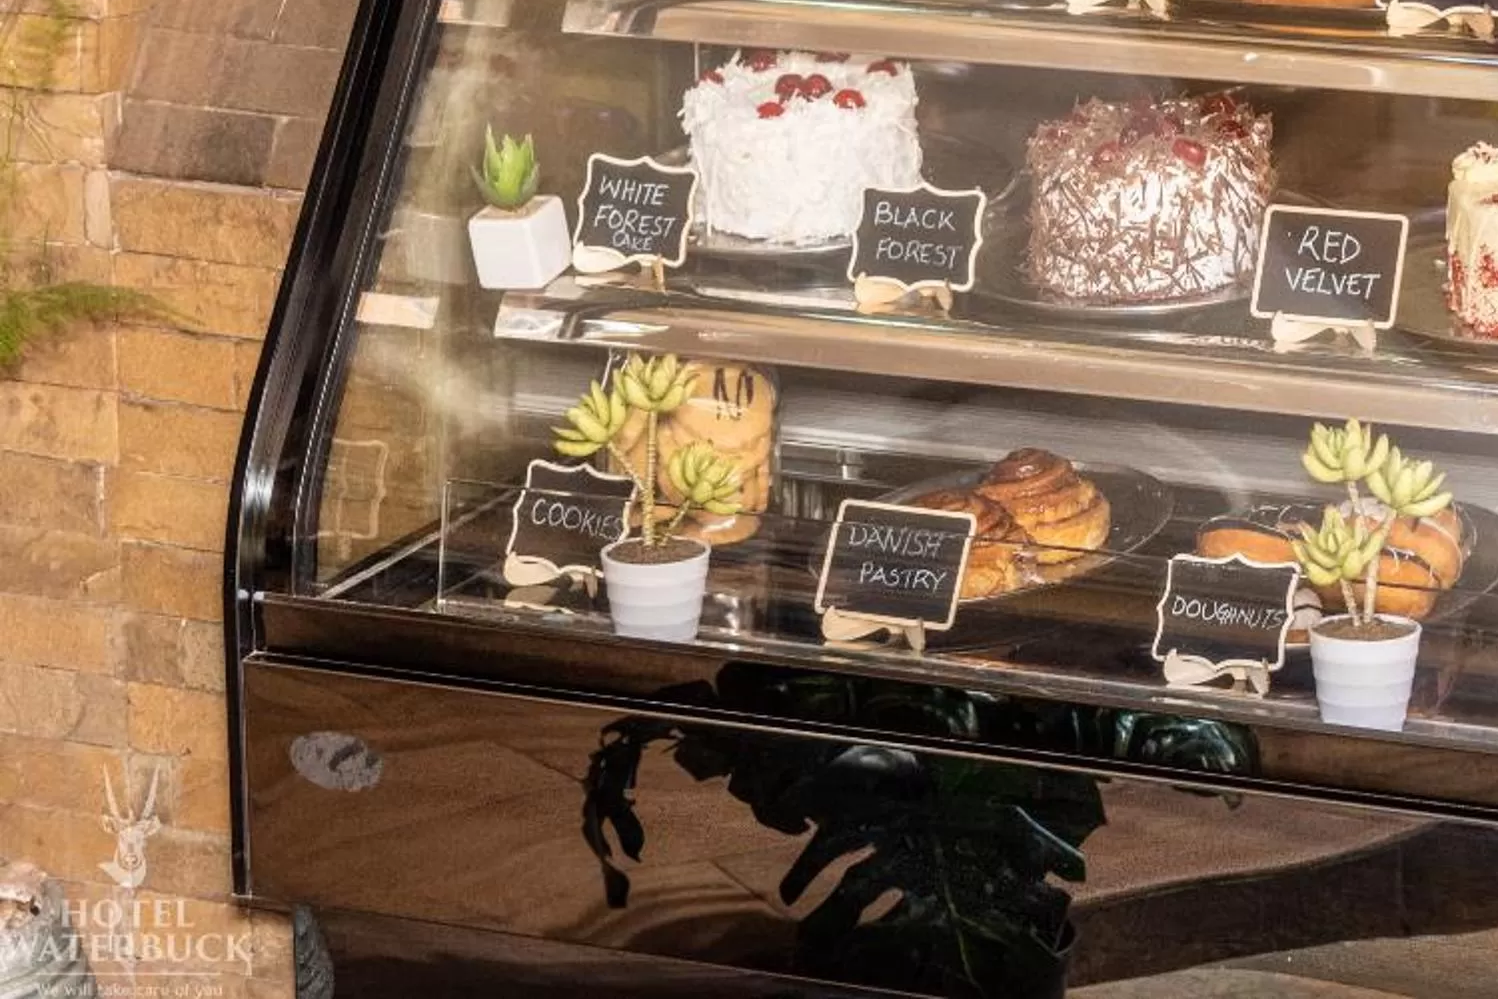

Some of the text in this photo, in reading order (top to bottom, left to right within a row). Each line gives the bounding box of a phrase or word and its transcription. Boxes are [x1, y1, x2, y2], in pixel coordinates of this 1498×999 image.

[599, 175, 669, 205] WHITE
[594, 204, 675, 238] FOREST
[874, 201, 956, 231] BLACK
[612, 229, 652, 251] CAKE
[876, 237, 963, 269] FOREST
[1298, 225, 1361, 264] RED
[1285, 267, 1381, 299] VELVET
[849, 525, 944, 559] DANISH
[859, 561, 947, 591] PASTRY
[1172, 596, 1285, 630] DOUGHNUTS
